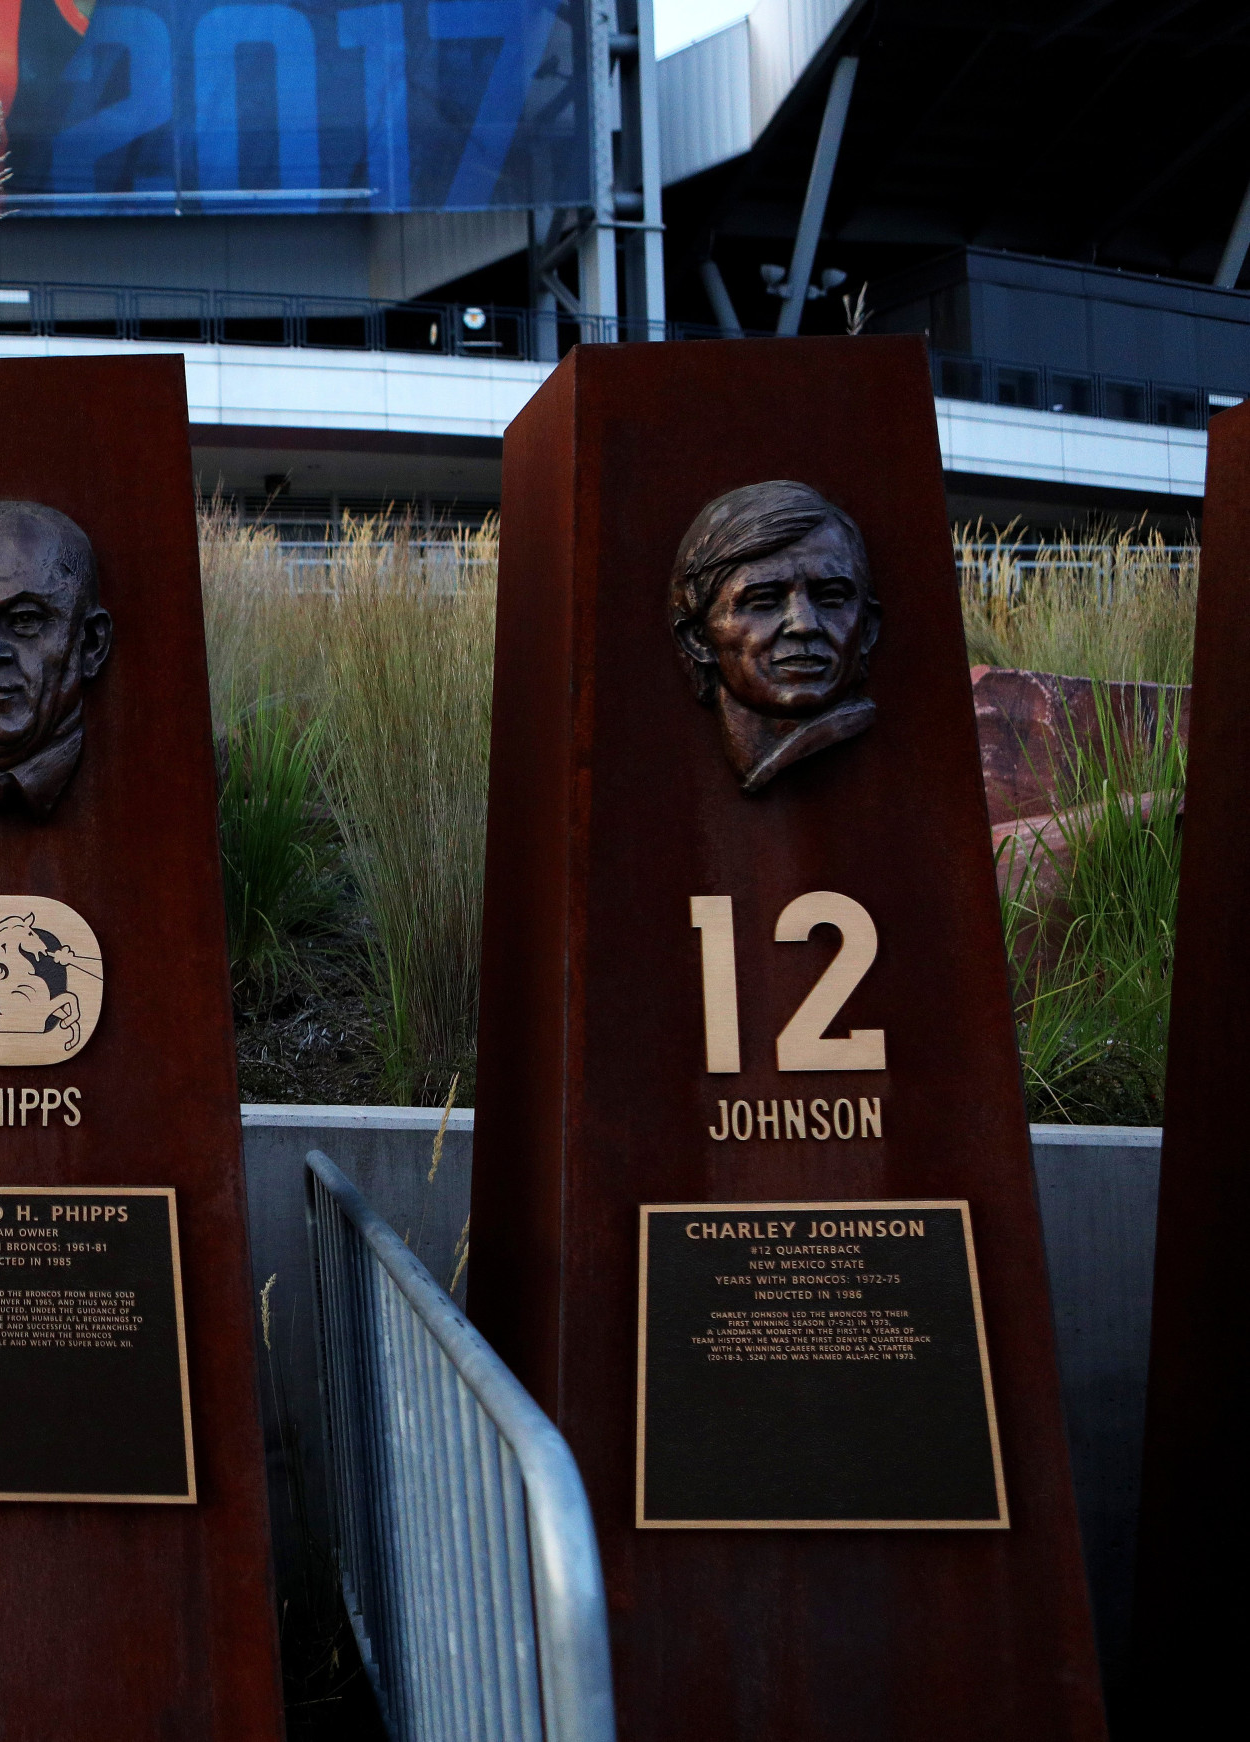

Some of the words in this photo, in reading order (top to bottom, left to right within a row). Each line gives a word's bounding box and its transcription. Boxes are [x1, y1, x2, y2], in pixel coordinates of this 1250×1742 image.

[50, 0, 556, 214] 2017
[690, 890, 887, 1074] 12
[708, 1097, 882, 1142] JOHNSON
[17, 1205, 39, 1222] H.
[52, 1206, 128, 1223] PHIPPS
[18, 1228, 59, 1237] OWNER
[685, 1222, 796, 1239] CHARLEY
[808, 1221, 925, 1238] JOHNSON
[6, 1242, 61, 1252] BRONCOS:
[66, 1243, 107, 1252] 1961-81
[751, 1246, 771, 1255] #12
[776, 1245, 861, 1255] QUARTERBACK
[30, 1257, 41, 1267] IN
[47, 1257, 72, 1267] 1985
[749, 1261, 775, 1271] NEW
[780, 1260, 826, 1270] MEXICO
[830, 1260, 864, 1270] STATE
[715, 1276, 752, 1286] YEARS
[756, 1276, 787, 1285] WITH
[792, 1275, 850, 1285] BRONCOS:
[856, 1275, 900, 1285] 1972-75
[25, 1290, 61, 1298] BRONCOS
[115, 1291, 135, 1299] SOLD
[754, 1291, 813, 1301] INDUCTED
[818, 1290, 830, 1300] IN
[836, 1290, 862, 1300] 1986
[32, 1315, 63, 1323] HUMBLE
[132, 1316, 143, 1324] TO
[710, 1311, 747, 1319] CHARLEY
[750, 1311, 789, 1319] JOHNSON
[884, 1310, 909, 1318] THEIR
[1, 1331, 29, 1339] OWNER
[76, 1332, 112, 1340] BRONCOS
[716, 1328, 763, 1336] LANDMARK
[765, 1328, 802, 1336] MOMENT
[790, 1353, 809, 1361] WAS
[812, 1353, 843, 1361] NAMED
